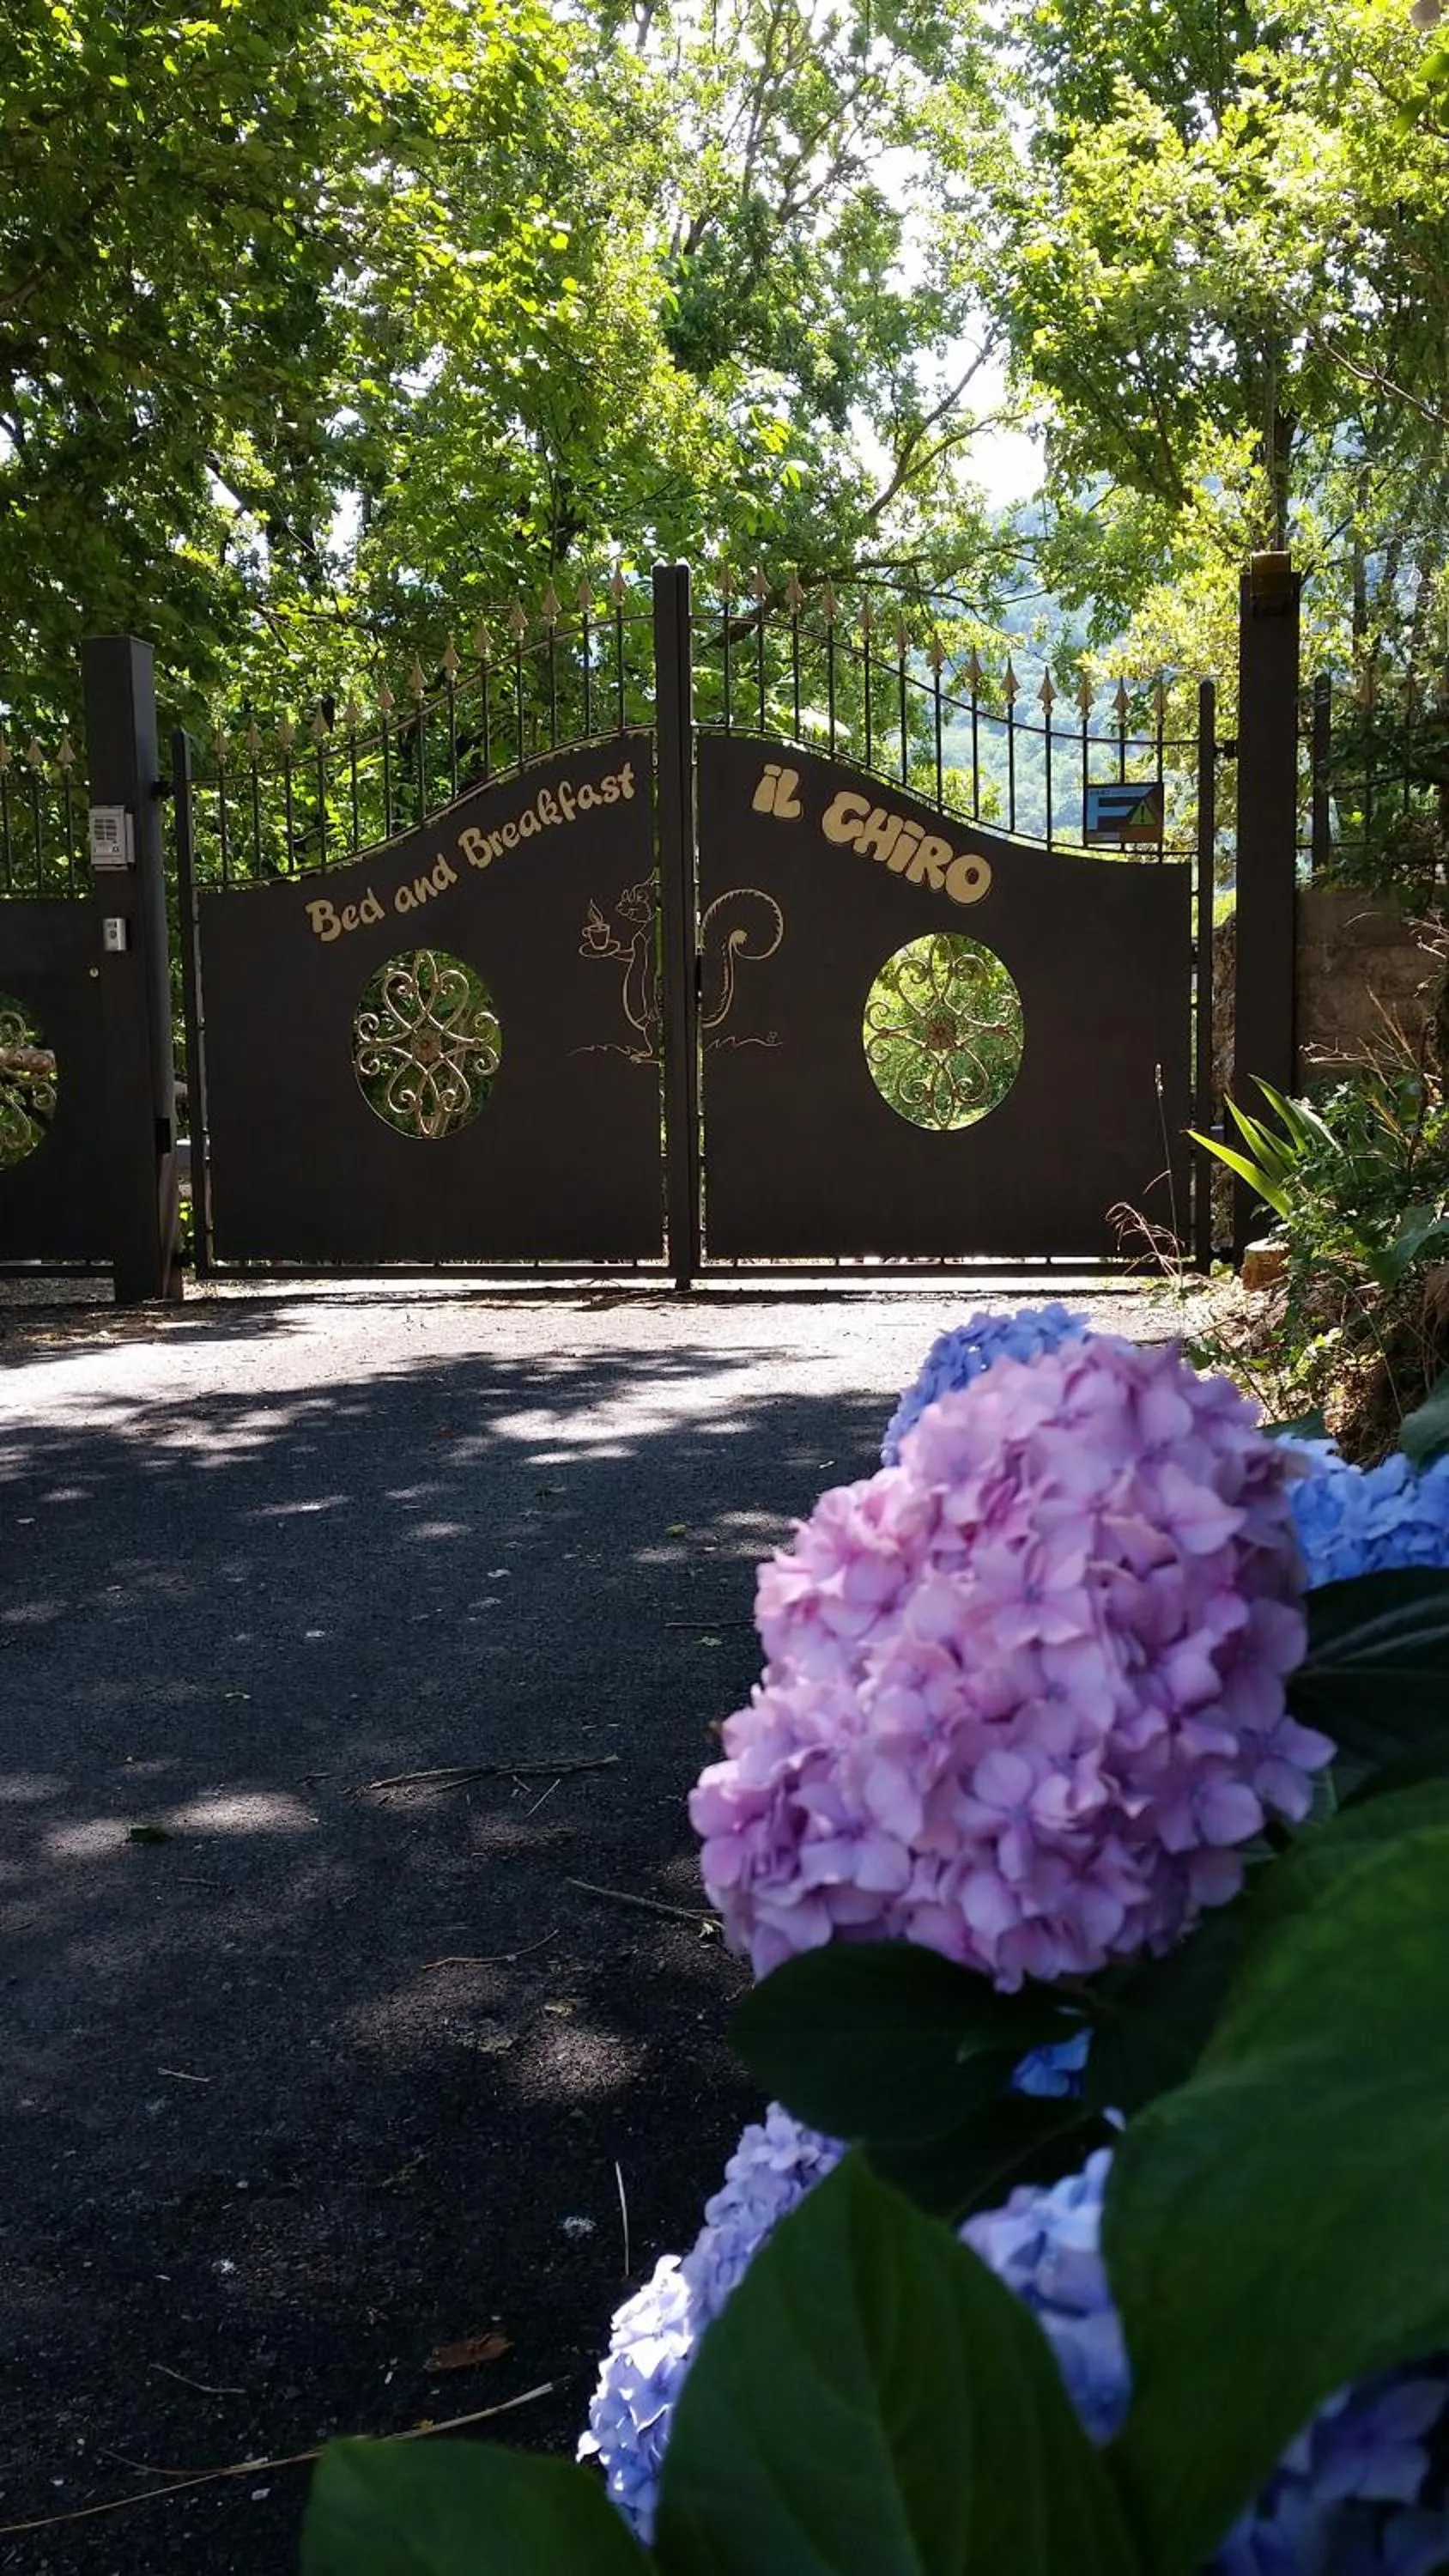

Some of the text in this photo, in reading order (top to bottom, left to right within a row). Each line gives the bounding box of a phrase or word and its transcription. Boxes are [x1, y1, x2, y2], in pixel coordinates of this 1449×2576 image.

[306, 762, 635, 942] Bed and Breakfast
